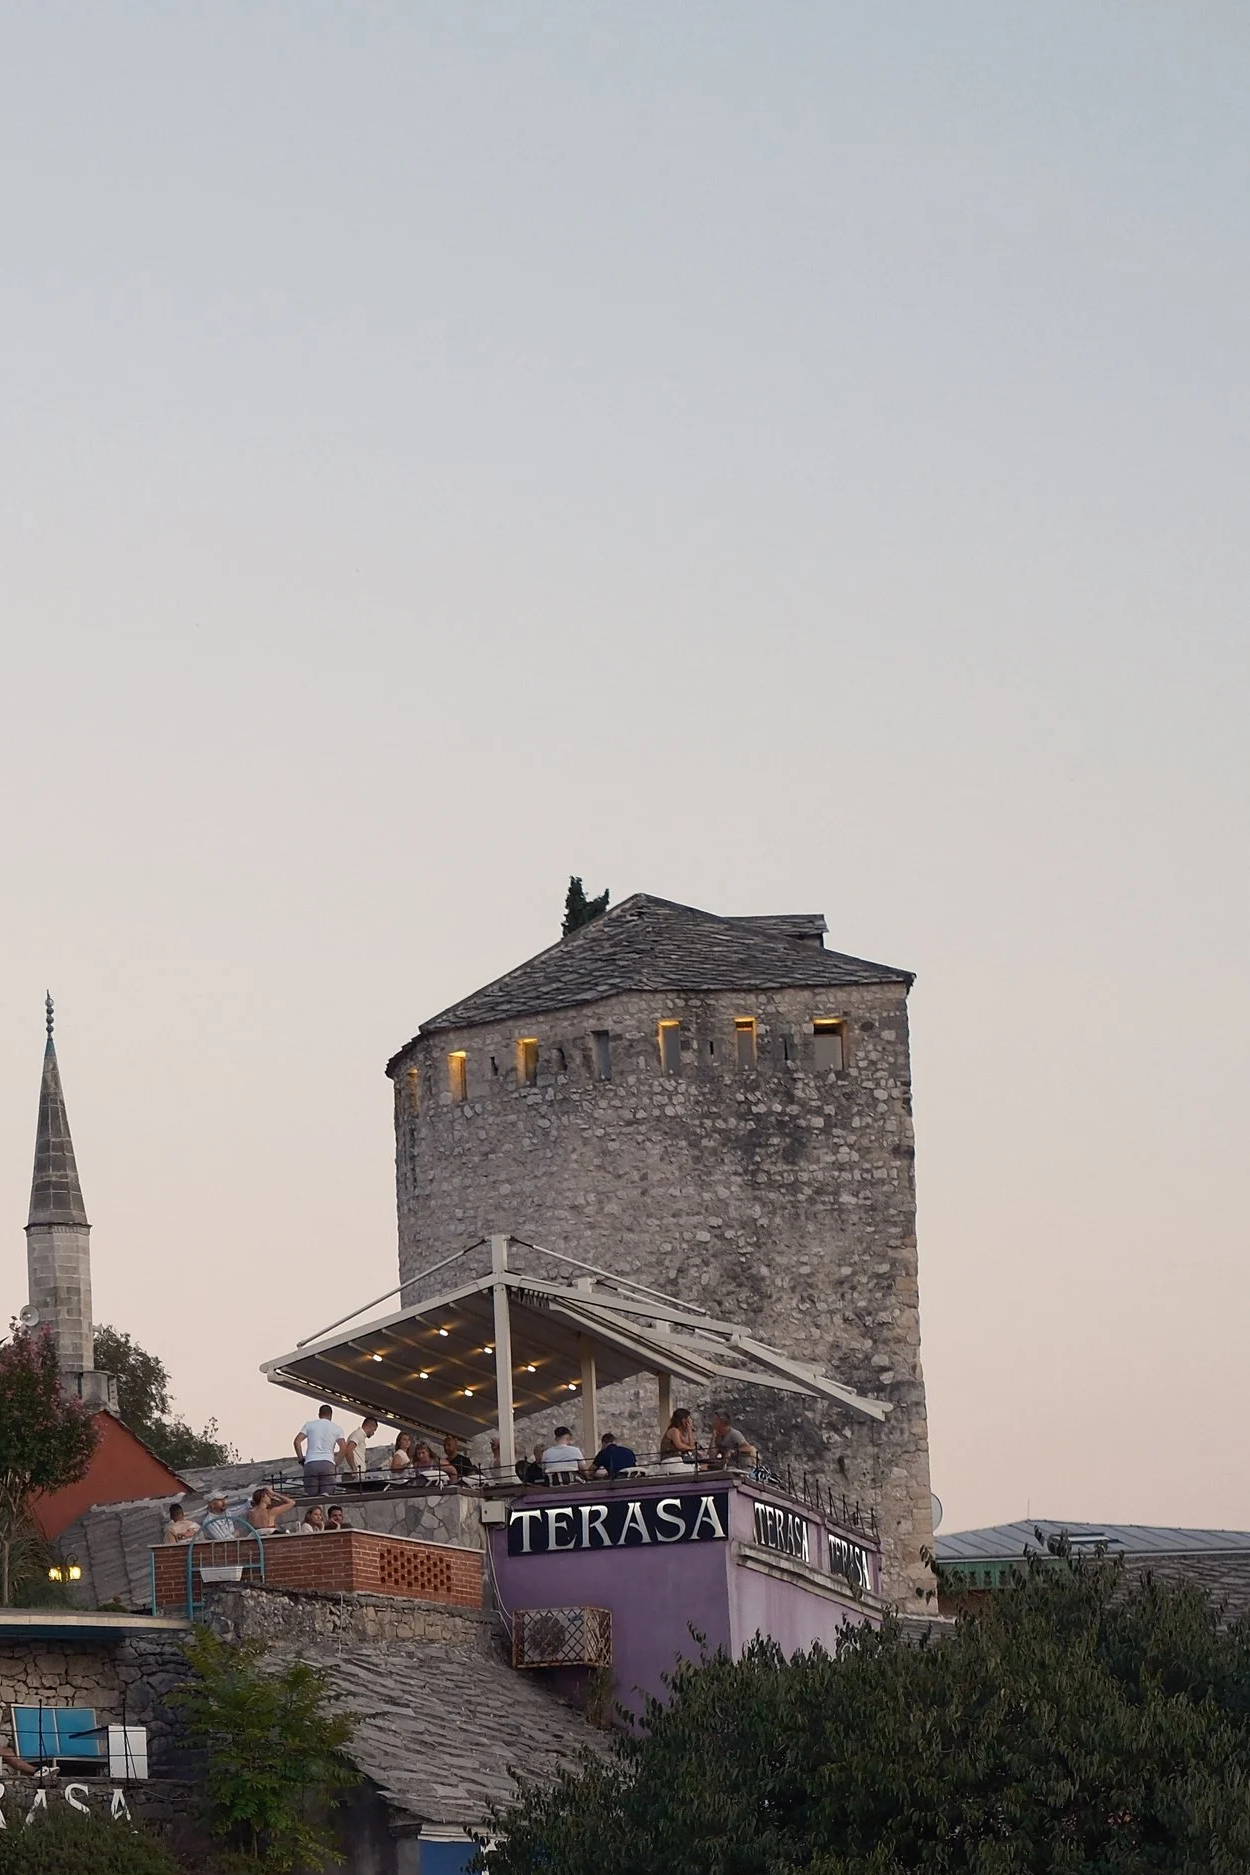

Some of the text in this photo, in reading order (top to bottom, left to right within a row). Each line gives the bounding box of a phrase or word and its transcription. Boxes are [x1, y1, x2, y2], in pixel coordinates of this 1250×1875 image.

[509, 1496, 726, 1553] TERASA
[753, 1501, 810, 1563] TERASA
[828, 1533, 871, 1591] TERASA
